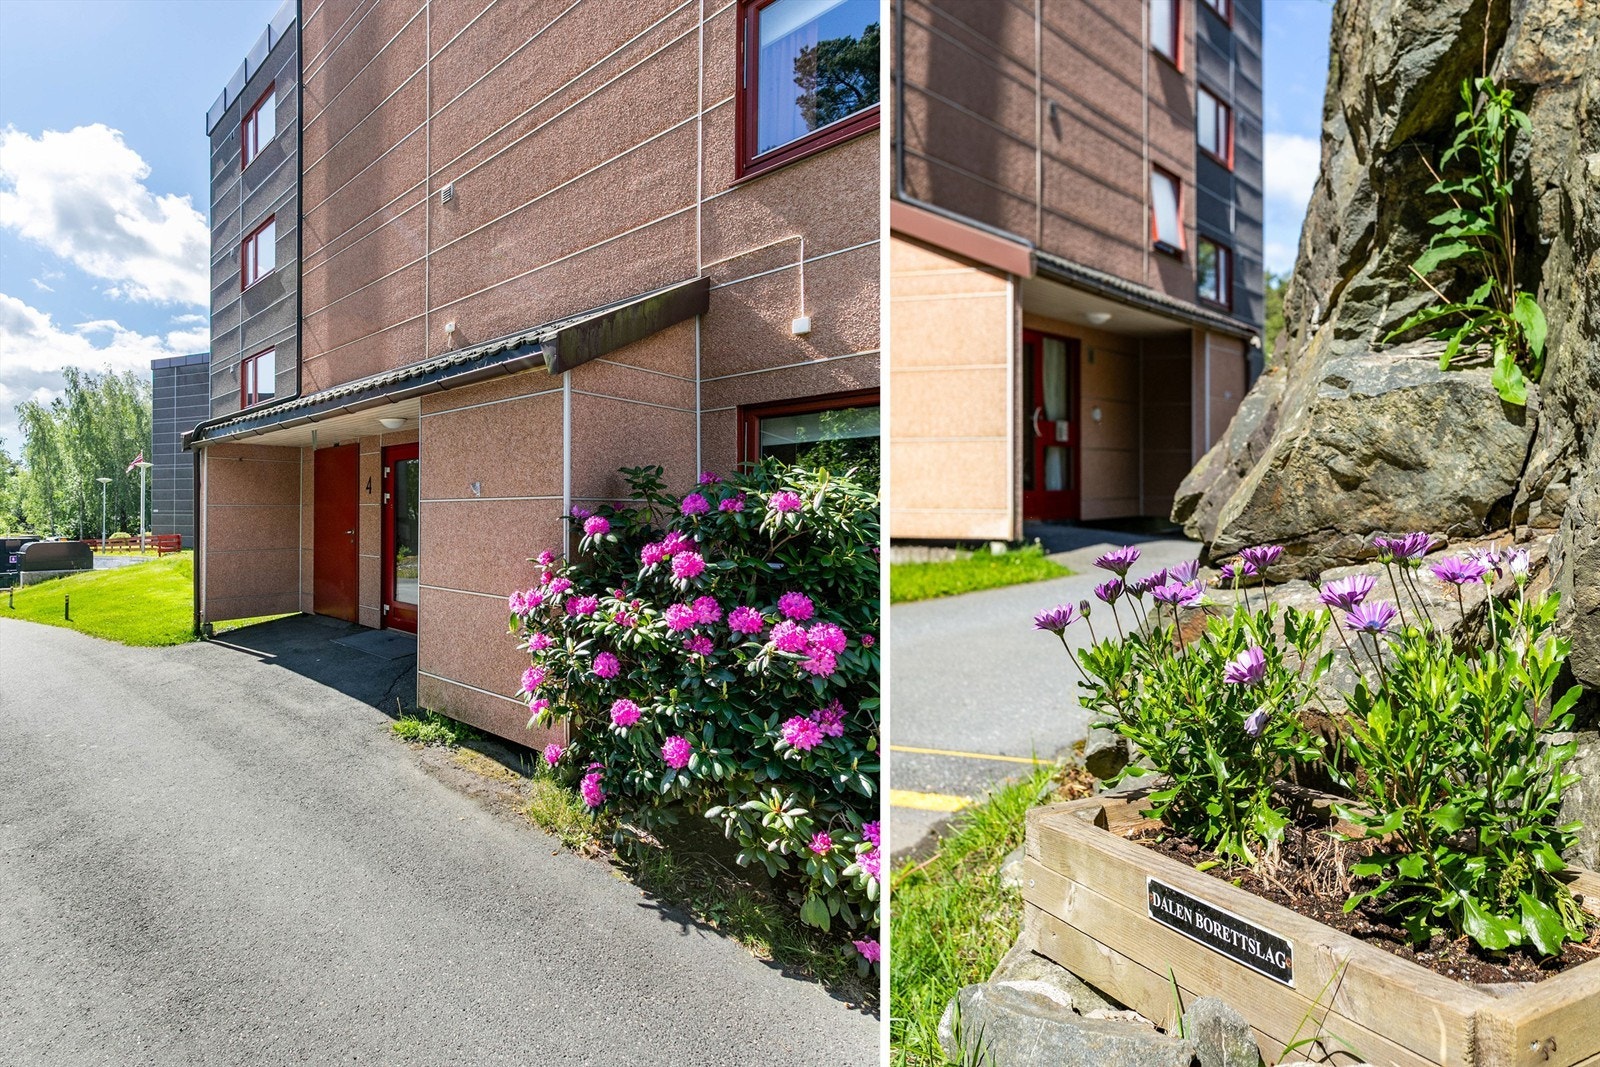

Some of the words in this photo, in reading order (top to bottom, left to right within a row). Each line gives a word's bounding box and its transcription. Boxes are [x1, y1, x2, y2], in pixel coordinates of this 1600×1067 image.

[366, 476, 372, 494] 4
[1152, 891, 1193, 924] DALEN
[1195, 912, 1286, 969] BORETTSLAG
